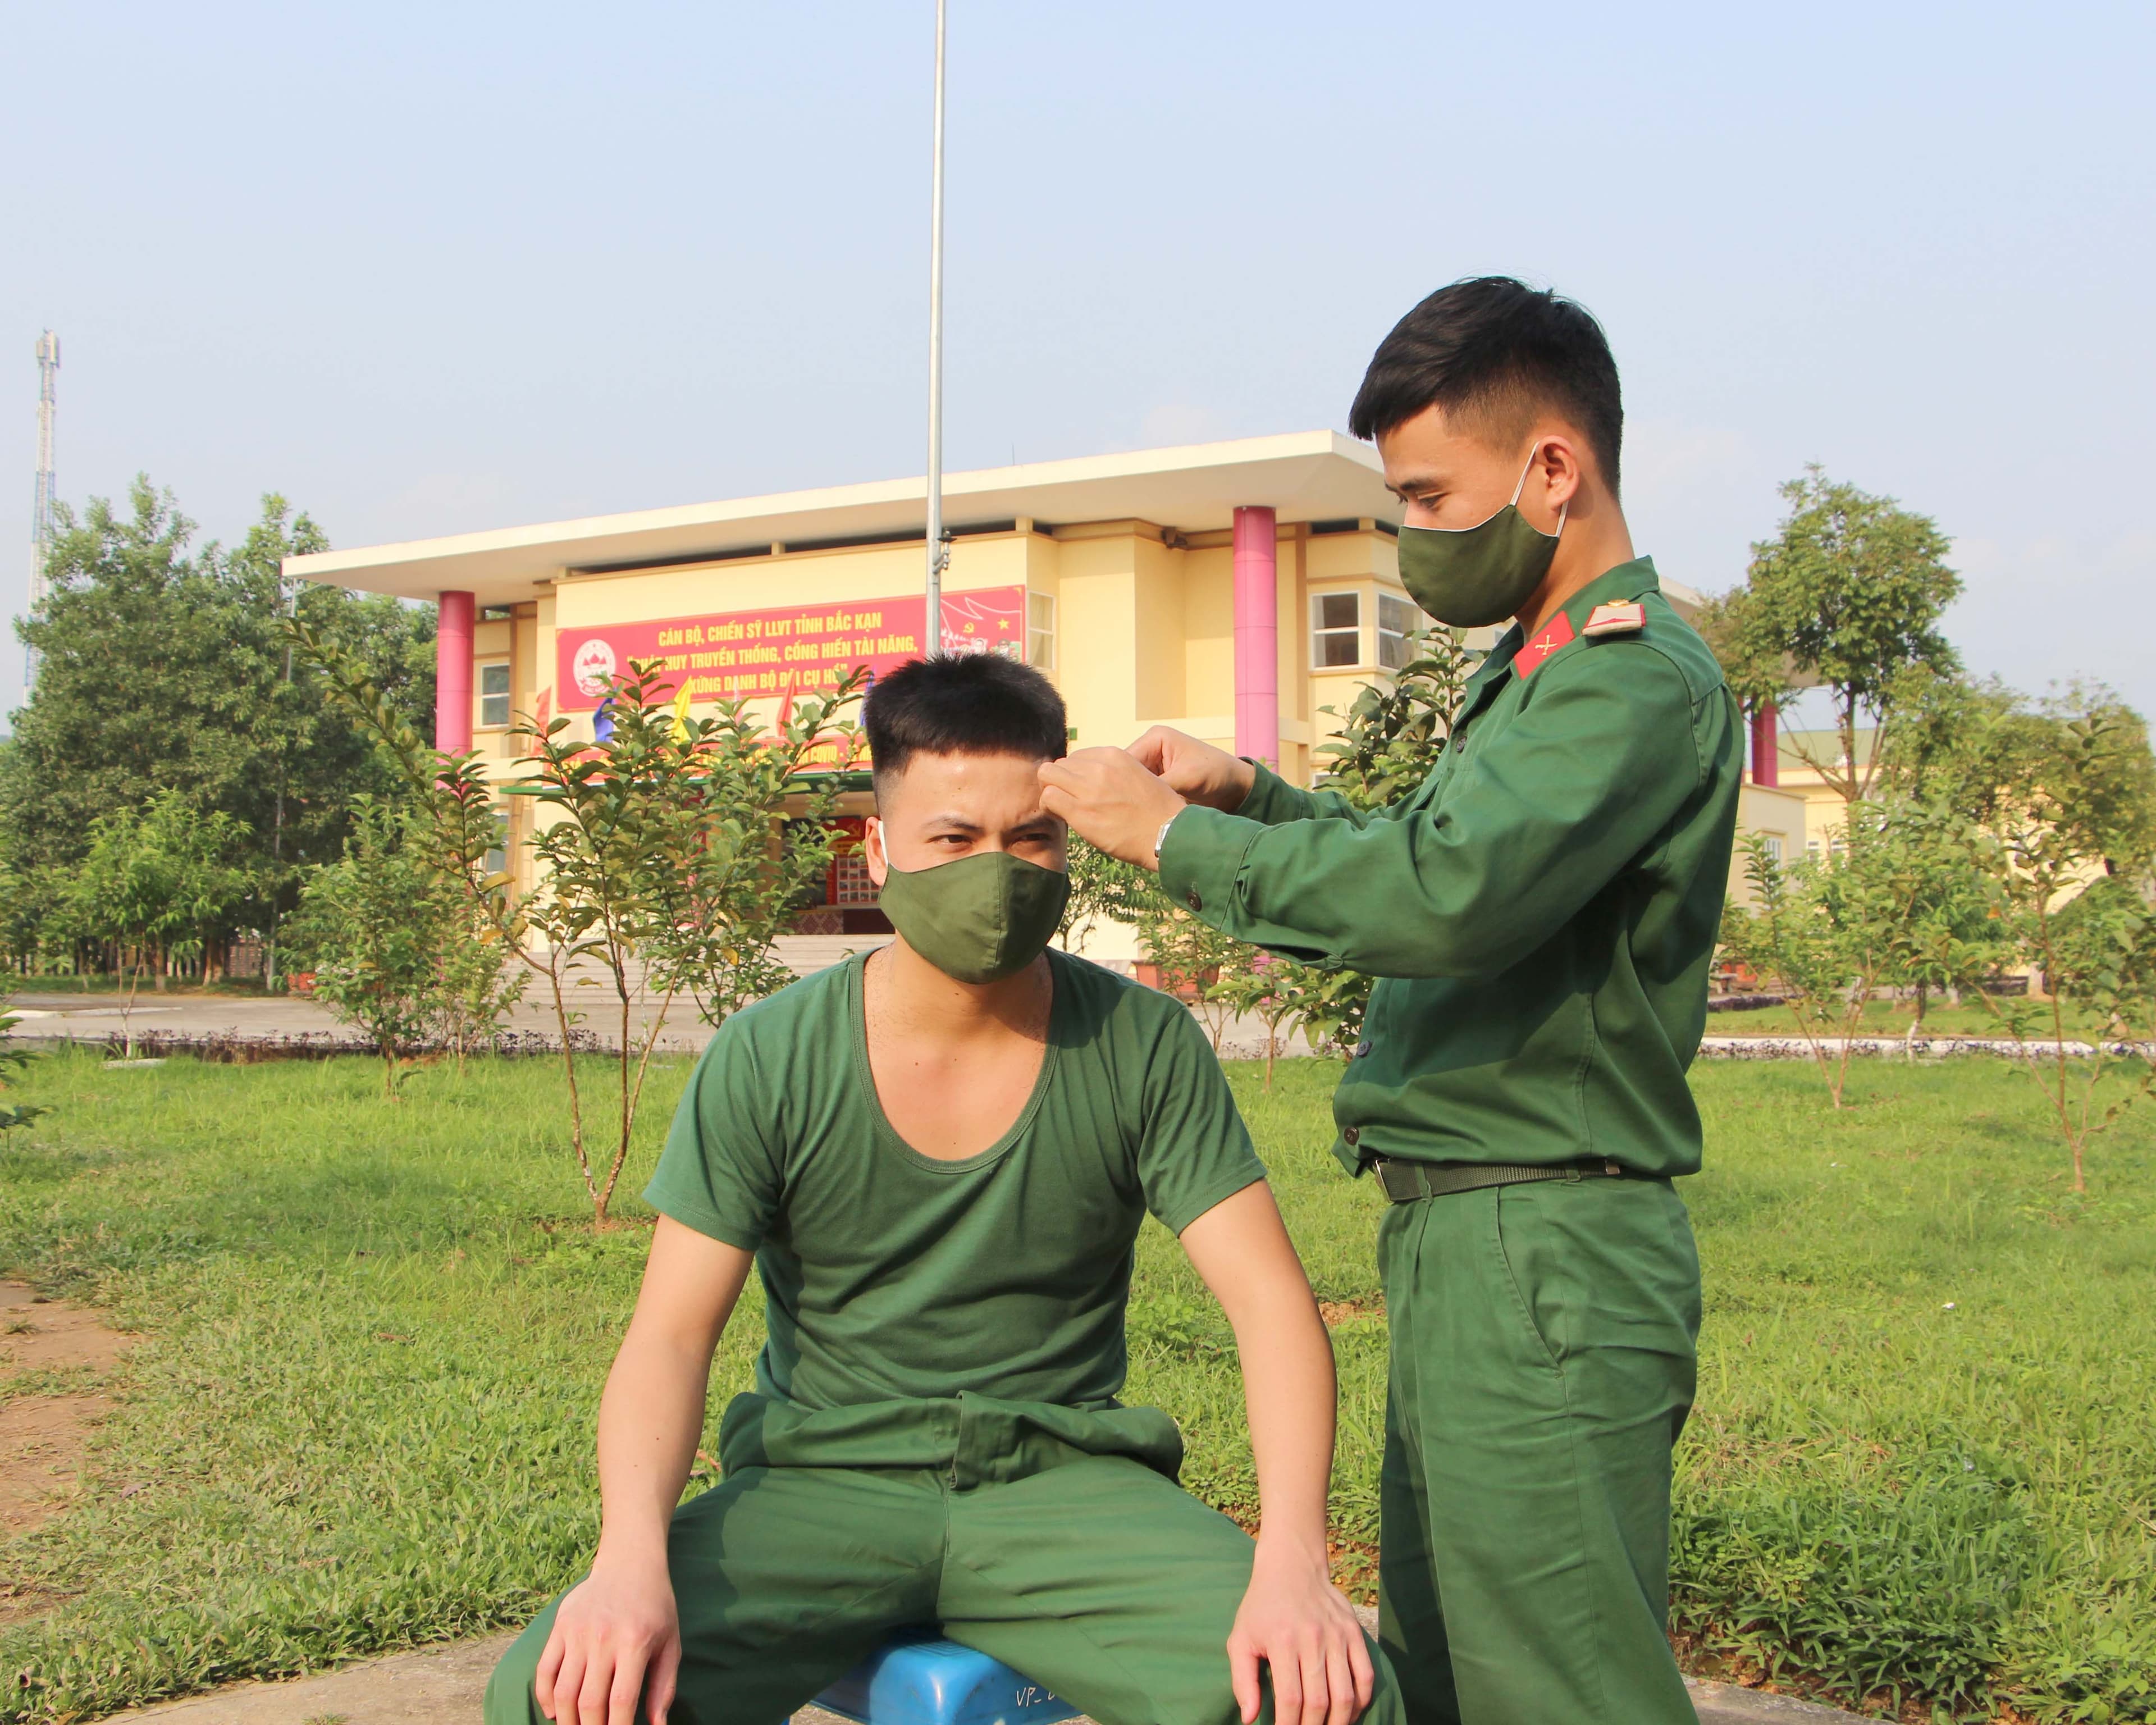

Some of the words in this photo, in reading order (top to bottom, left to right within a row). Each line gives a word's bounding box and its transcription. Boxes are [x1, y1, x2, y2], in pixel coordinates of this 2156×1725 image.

[659, 627, 683, 646] CÁN
[686, 625, 705, 647] BỘ,
[707, 619, 744, 642] CHIẾN
[747, 619, 762, 638] SỸ
[765, 619, 792, 637] LLVT
[794, 613, 823, 635] TỈNH
[826, 609, 852, 632] BẮC
[855, 612, 881, 632] KẠN
[665, 654, 688, 672] HUY
[738, 642, 782, 664] THỐNG,
[784, 639, 818, 661] CỐNG
[821, 636, 851, 659] HIẾN
[854, 636, 874, 656] TÀI
[878, 634, 917, 654] NĂNG,
[760, 669, 776, 691] BỘ
[803, 669, 820, 688] CỤ
